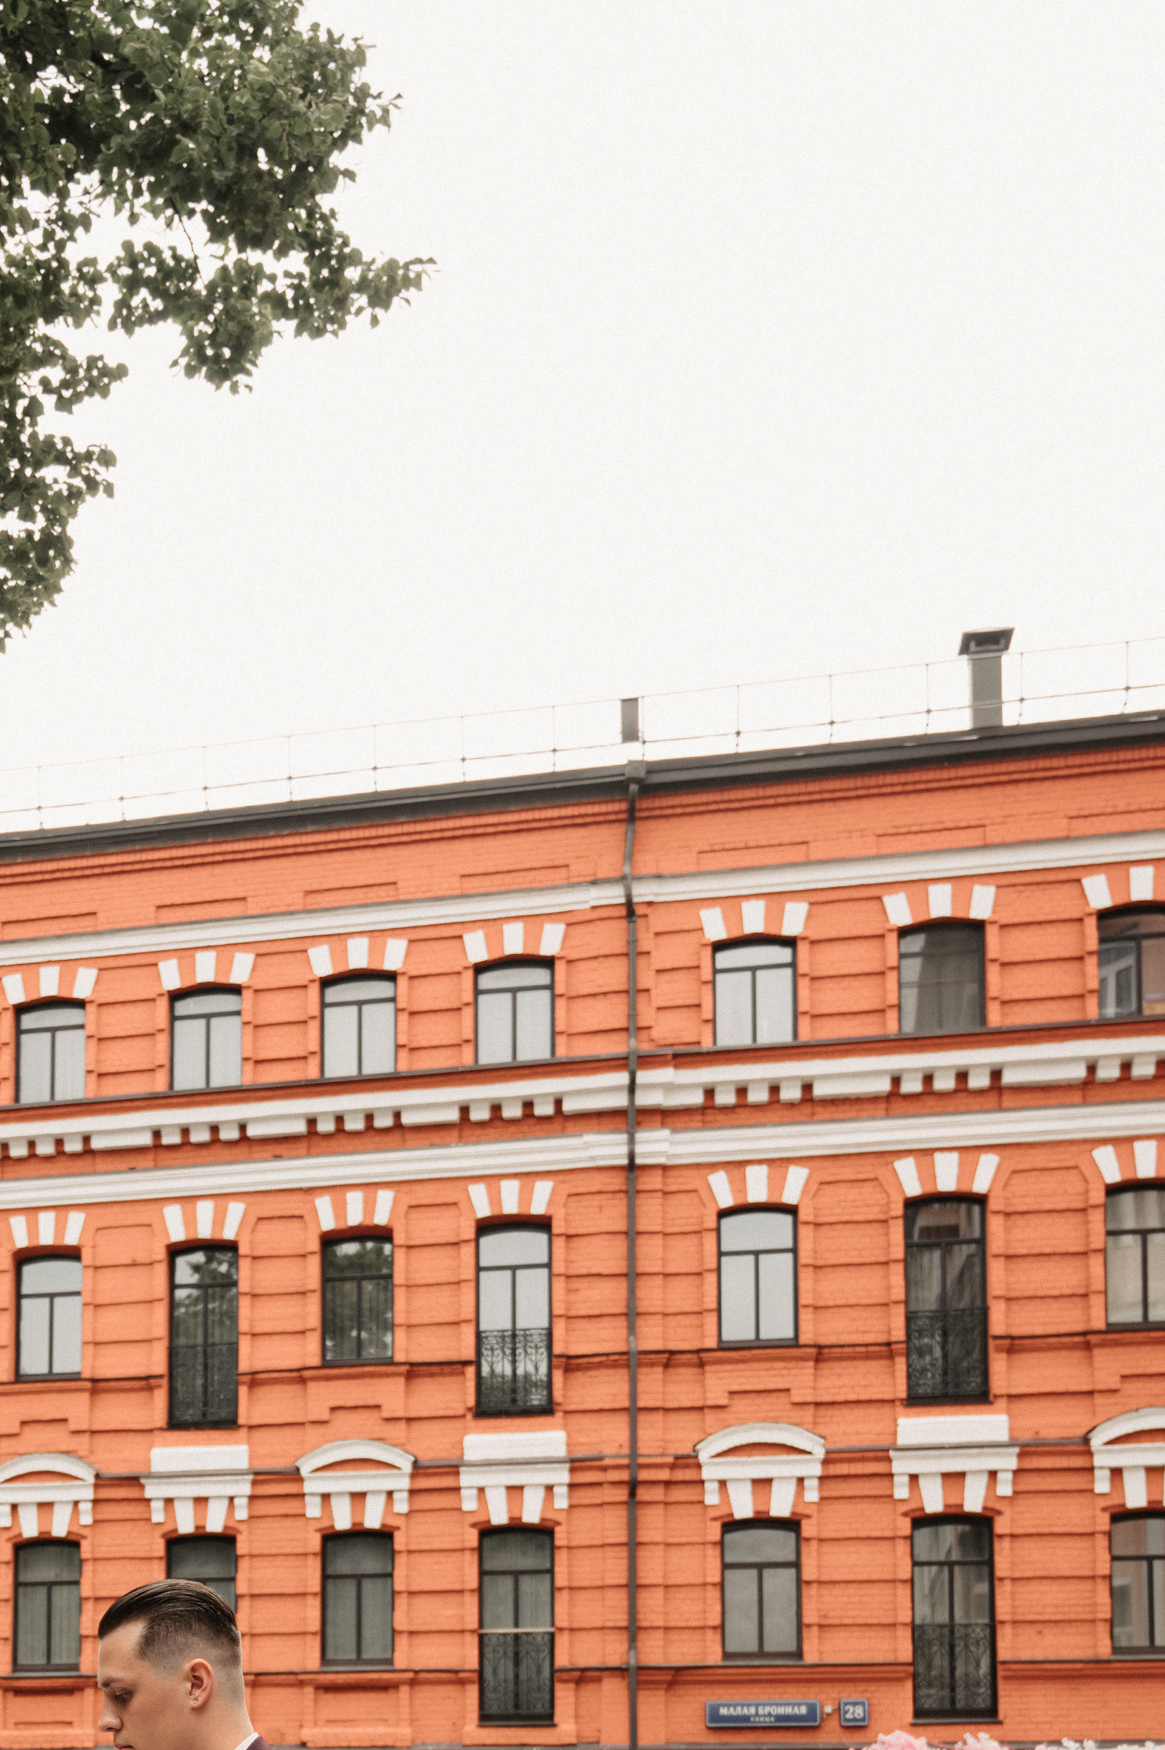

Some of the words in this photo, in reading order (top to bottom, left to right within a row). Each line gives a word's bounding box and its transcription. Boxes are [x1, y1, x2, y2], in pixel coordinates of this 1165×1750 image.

[719, 1706, 755, 1716] МАЛАЯ
[758, 1705, 807, 1716] БРОННАЯ
[844, 1704, 864, 1720] 28
